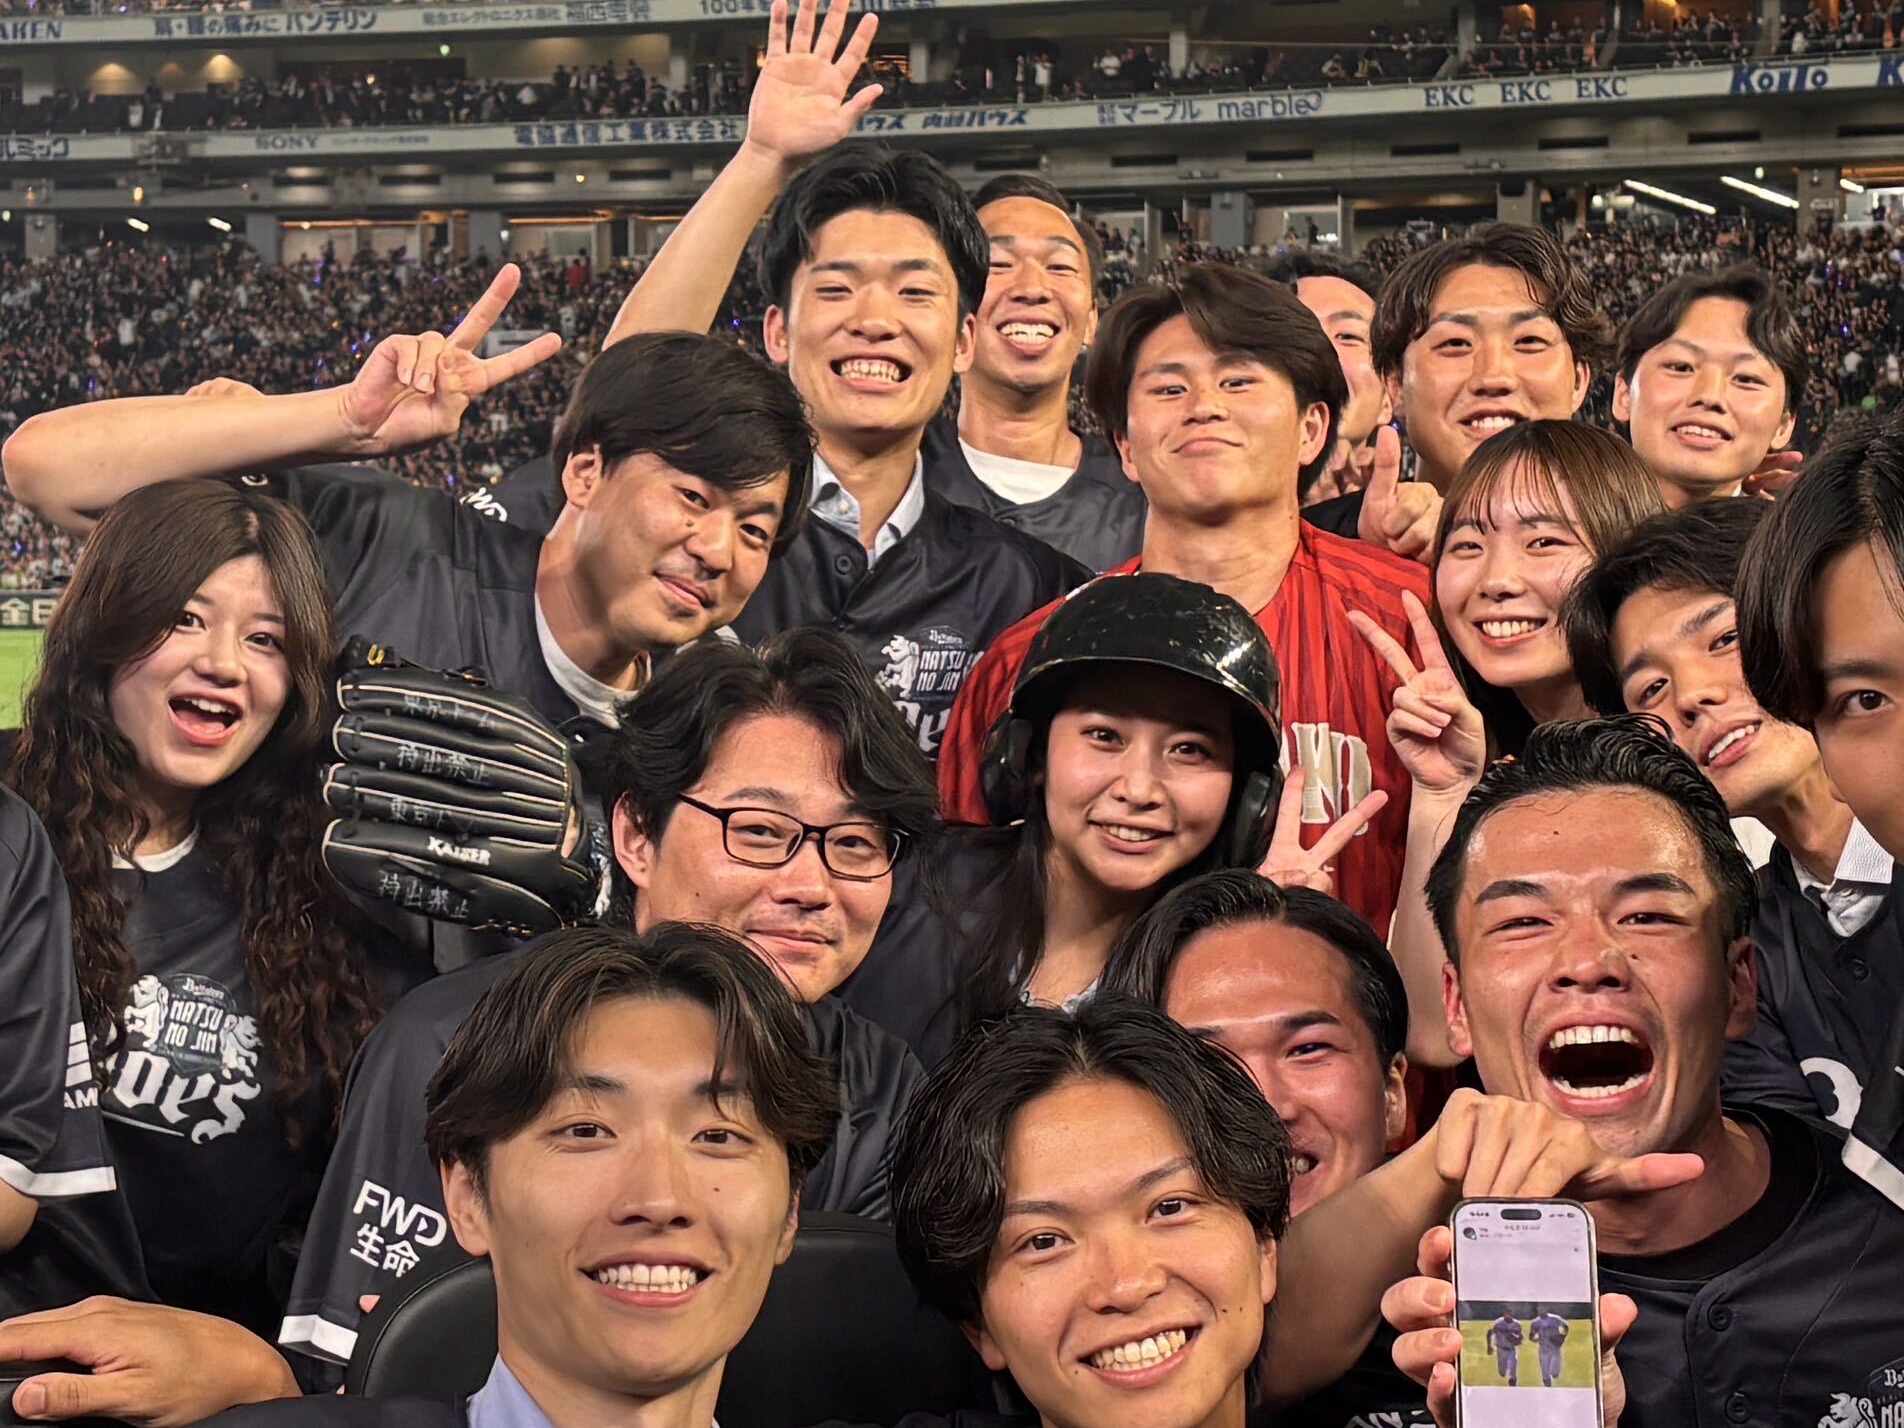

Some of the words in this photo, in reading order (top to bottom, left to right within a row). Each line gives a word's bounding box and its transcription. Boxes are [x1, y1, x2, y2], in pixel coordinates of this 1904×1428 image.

[1425, 85, 1475, 107] EKC
[1500, 81, 1552, 103] EKC
[1576, 76, 1628, 99] EKC
[256, 134, 320, 149] SONY
[920, 651, 966, 670] NATSU
[917, 672, 936, 691] NO
[427, 836, 491, 866] KAISER
[170, 1000, 224, 1031] NATSU
[165, 1022, 188, 1047] NO
[190, 1031, 218, 1054] JIN
[352, 1180, 446, 1247] FWD
[350, 1224, 421, 1278] 生命
